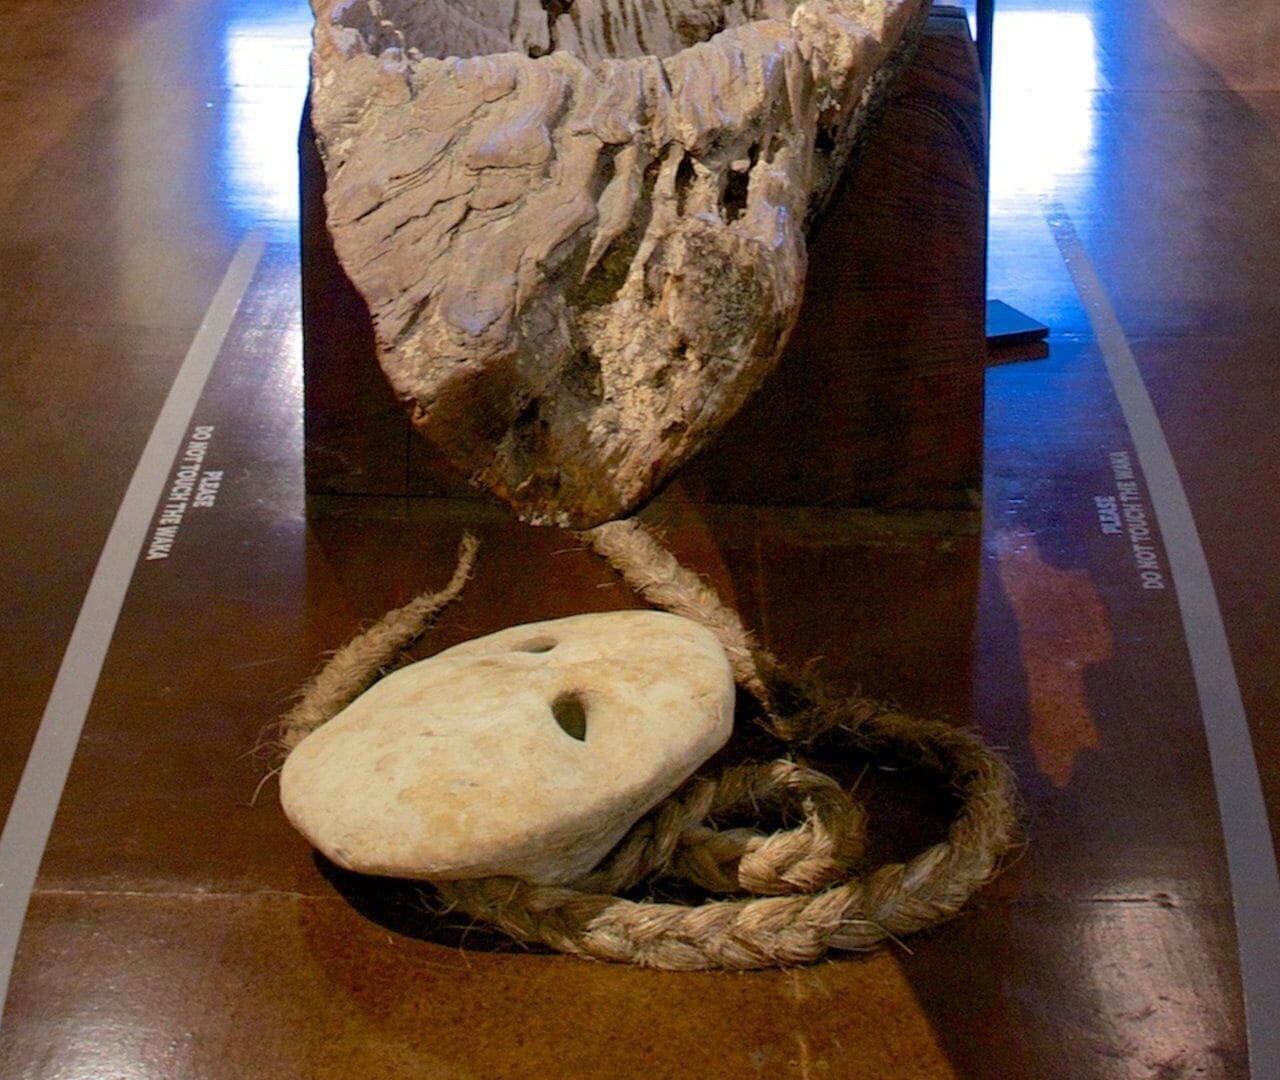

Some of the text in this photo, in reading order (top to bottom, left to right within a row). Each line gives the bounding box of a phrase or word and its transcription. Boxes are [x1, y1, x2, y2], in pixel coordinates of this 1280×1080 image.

[145, 425, 214, 560] DO NOT TOUCH THE WAKA
[192, 470, 224, 507] PLEASE
[1094, 495, 1122, 535] PLEASE
[1109, 451, 1165, 589] DO NOT TOUCH THE WAKA
